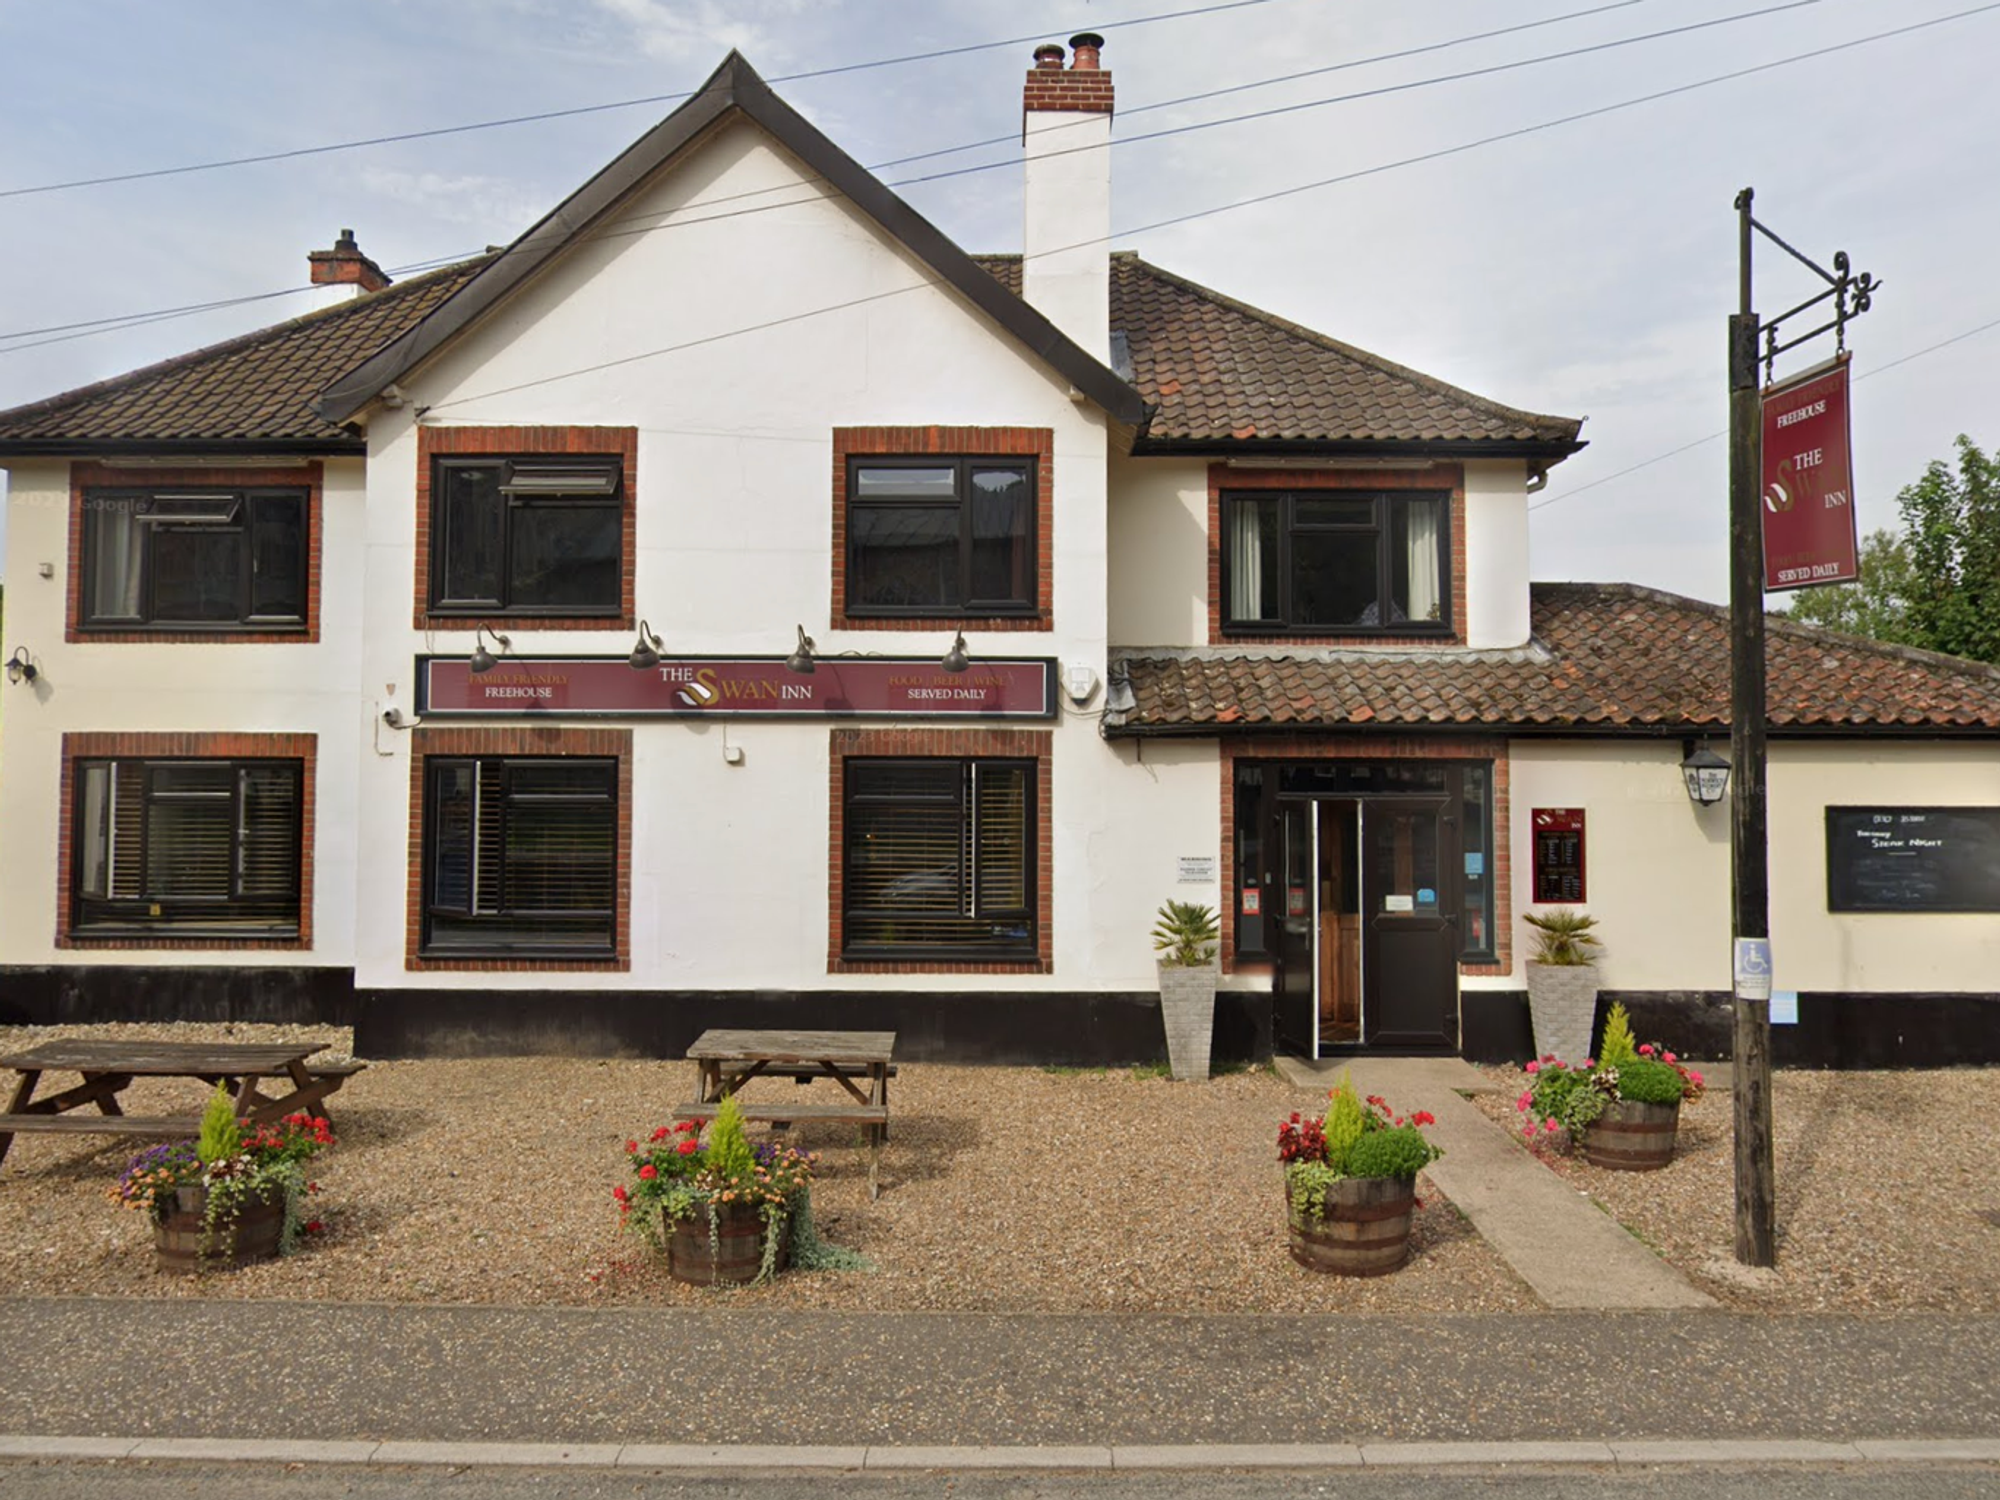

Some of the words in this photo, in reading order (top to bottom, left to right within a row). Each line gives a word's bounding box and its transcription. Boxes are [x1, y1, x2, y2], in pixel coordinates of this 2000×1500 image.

[1777, 399, 1827, 429] FREEHOUSE
[1793, 447, 1823, 471] THE
[1824, 489, 1847, 509] INN
[1777, 566, 1811, 583] SERVED
[1812, 561, 1840, 578] DAILY
[469, 674, 509, 684] FAMILY
[513, 674, 568, 684] FRIENDLY
[888, 675, 922, 686] FOOD
[933, 675, 963, 686] BEER
[485, 687, 552, 698] FREEHOUSE
[659, 668, 693, 681] THE
[677, 668, 779, 706] SWAN
[781, 686, 812, 699] INN
[907, 688, 952, 699] SERVED
[953, 688, 987, 699] DAILY
[1909, 838, 1943, 847] NIGHT
